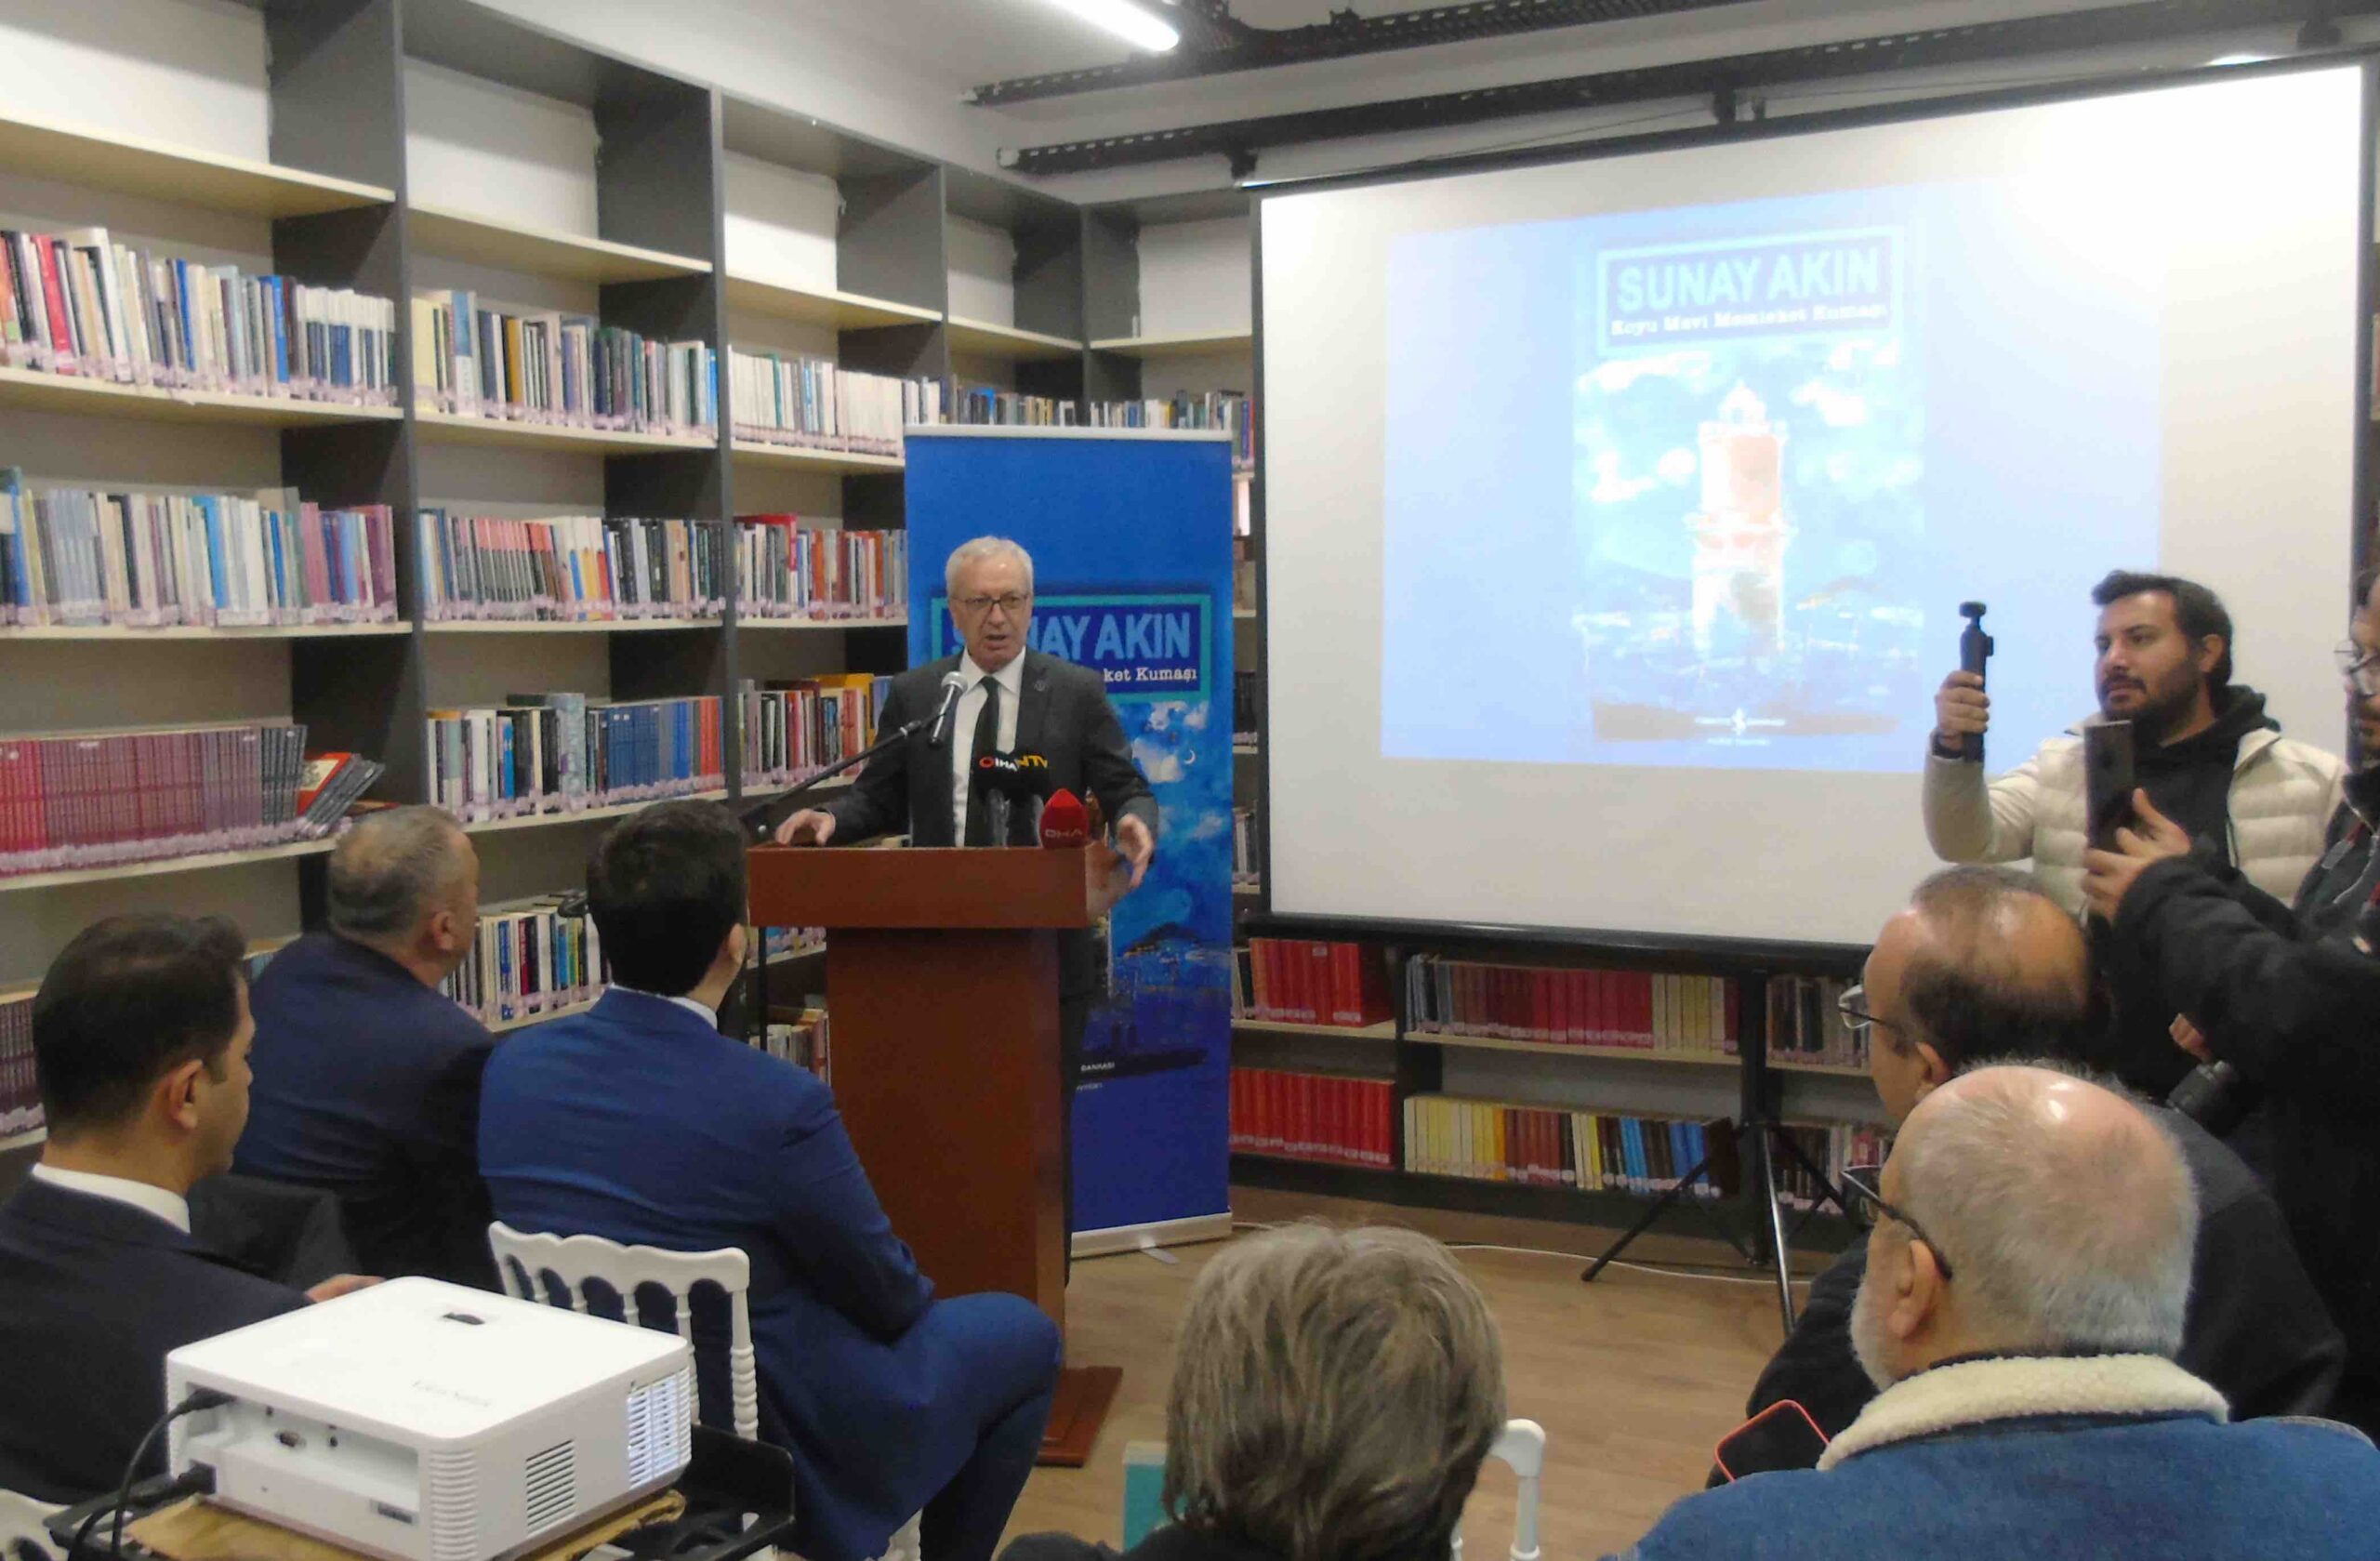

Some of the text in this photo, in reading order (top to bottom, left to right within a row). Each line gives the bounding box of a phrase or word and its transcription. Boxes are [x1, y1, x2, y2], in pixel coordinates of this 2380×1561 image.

[1617, 247, 1879, 313] SUNAY AKIN
[1094, 613, 1190, 660] AKIN
[1135, 667, 1197, 683] Kumaşı
